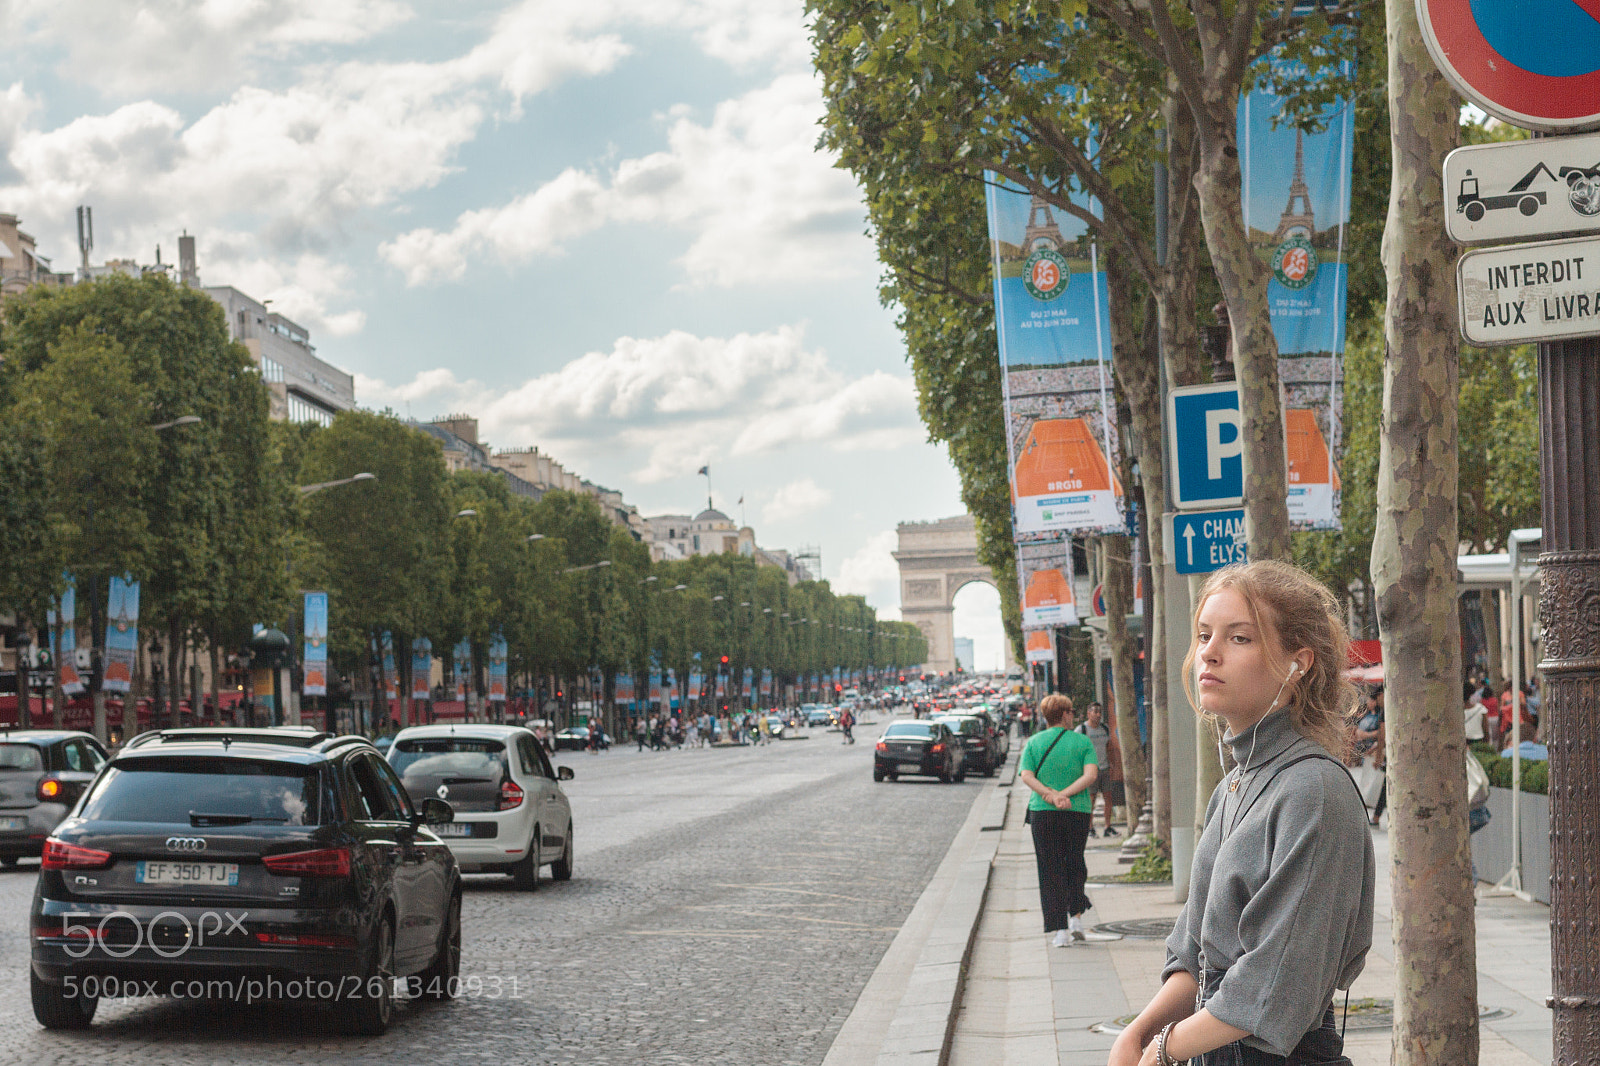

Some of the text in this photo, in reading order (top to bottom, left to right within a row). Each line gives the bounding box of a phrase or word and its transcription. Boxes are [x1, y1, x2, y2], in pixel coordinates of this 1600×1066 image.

[1488, 257, 1584, 291] INTERDIT
[1031, 311, 1042, 319] DU
[1051, 309, 1067, 318] MAI
[1483, 300, 1526, 328] AUX
[1021, 317, 1079, 329] AU 10 JUIN 2018
[1205, 408, 1243, 480] P
[1047, 479, 1083, 492] #RG18
[75, 875, 98, 886] Q3
